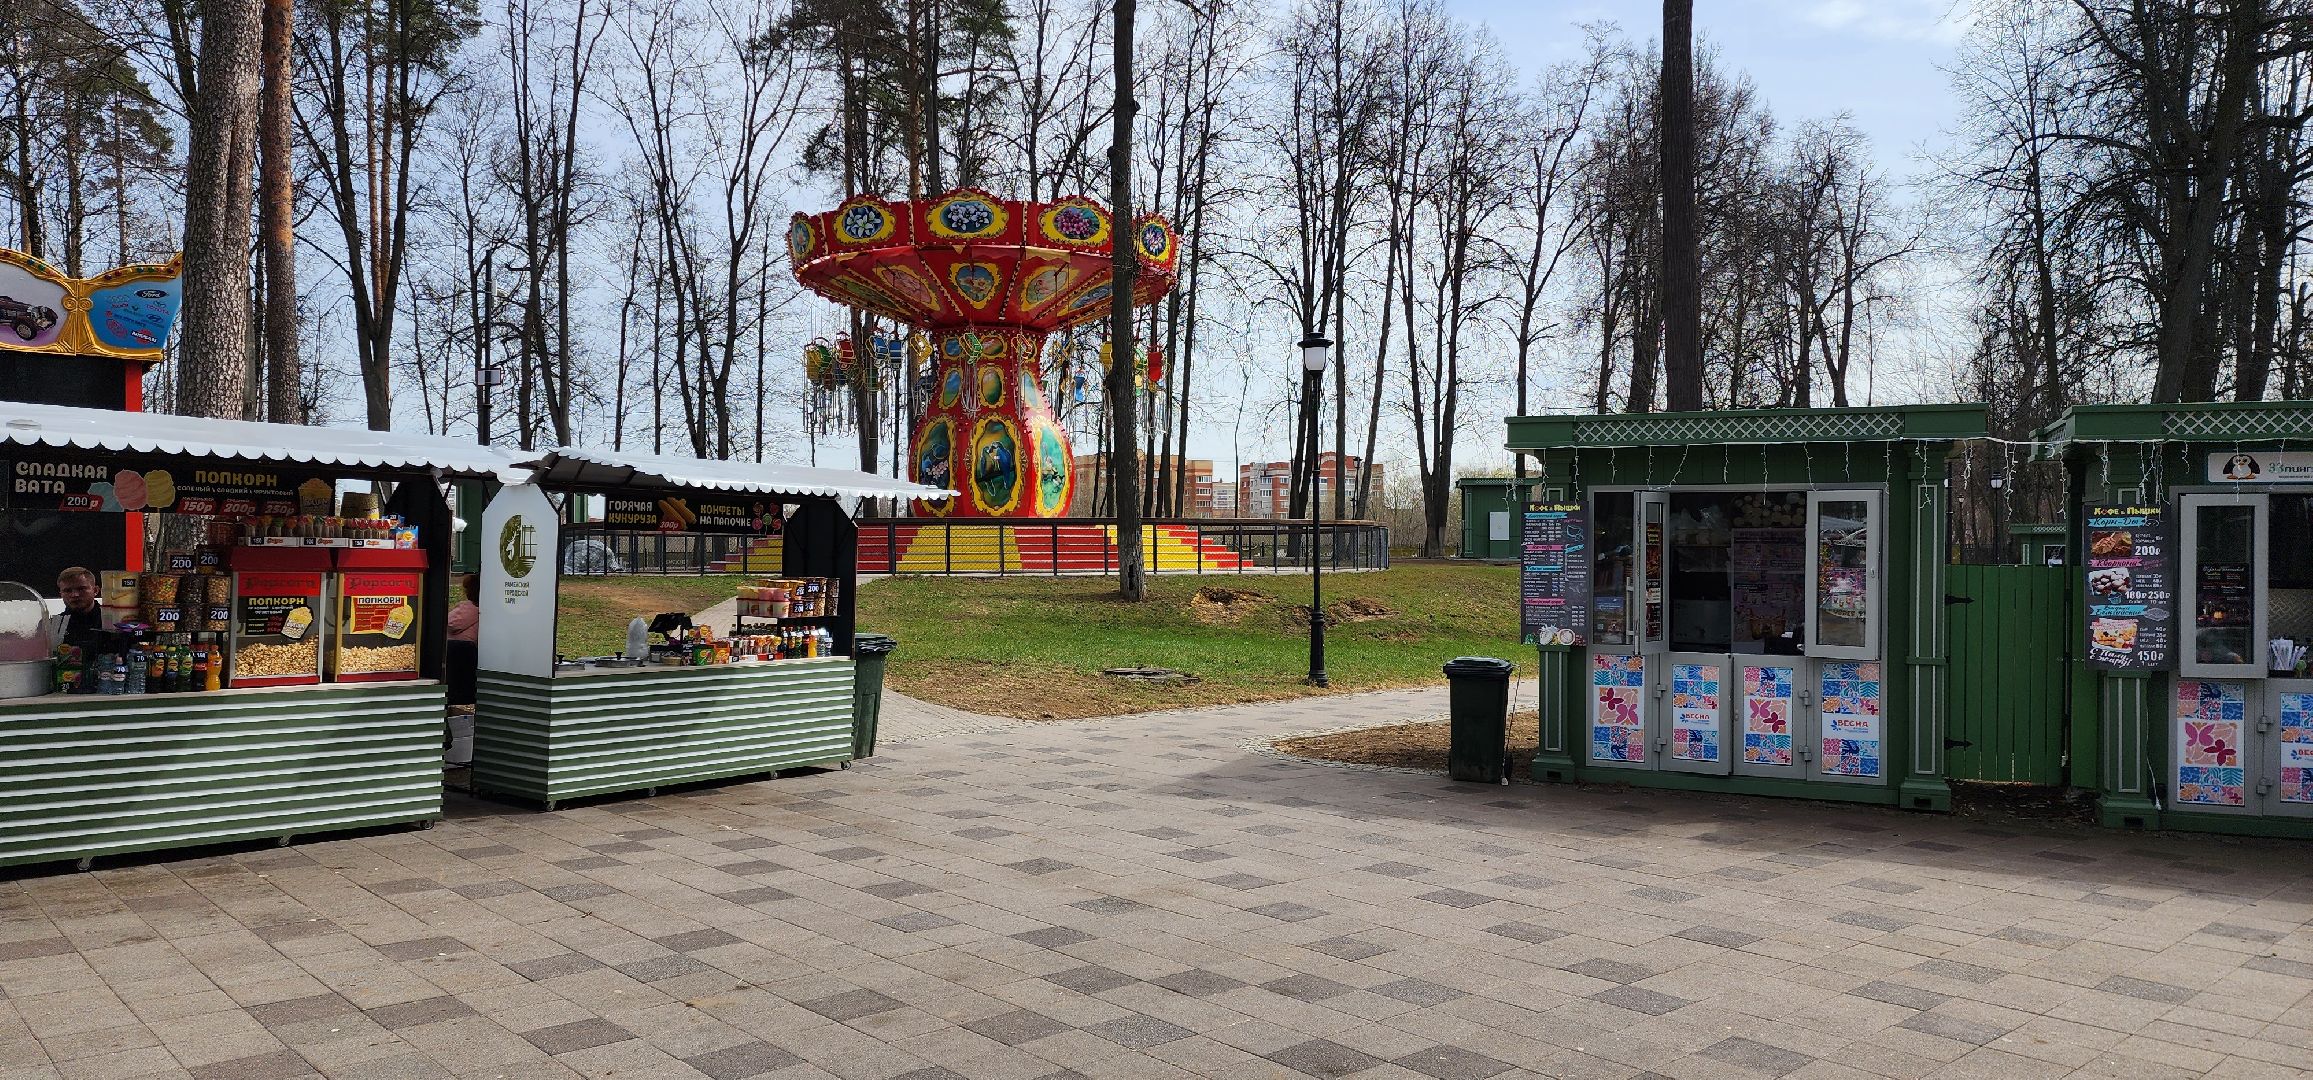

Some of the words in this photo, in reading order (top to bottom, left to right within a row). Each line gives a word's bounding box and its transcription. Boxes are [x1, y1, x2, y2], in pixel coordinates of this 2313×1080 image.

[16, 462, 108, 478] СЛАДКАЯ
[196, 470, 277, 486] ПОПКОРН
[16, 479, 65, 494] ВАТА
[608, 500, 652, 512] ГОРЯЧАЯ
[701, 504, 744, 515] КОНФЕТЫ
[608, 513, 656, 524] КУКУРУЗА
[700, 516, 712, 525] НА
[714, 517, 751, 526] ПАЛОЧКЕ
[172, 560, 192, 568] 200
[200, 556, 218, 564] 200
[248, 598, 304, 606] ПОПКОРН
[160, 612, 180, 620] 200
[211, 610, 228, 620] 200
